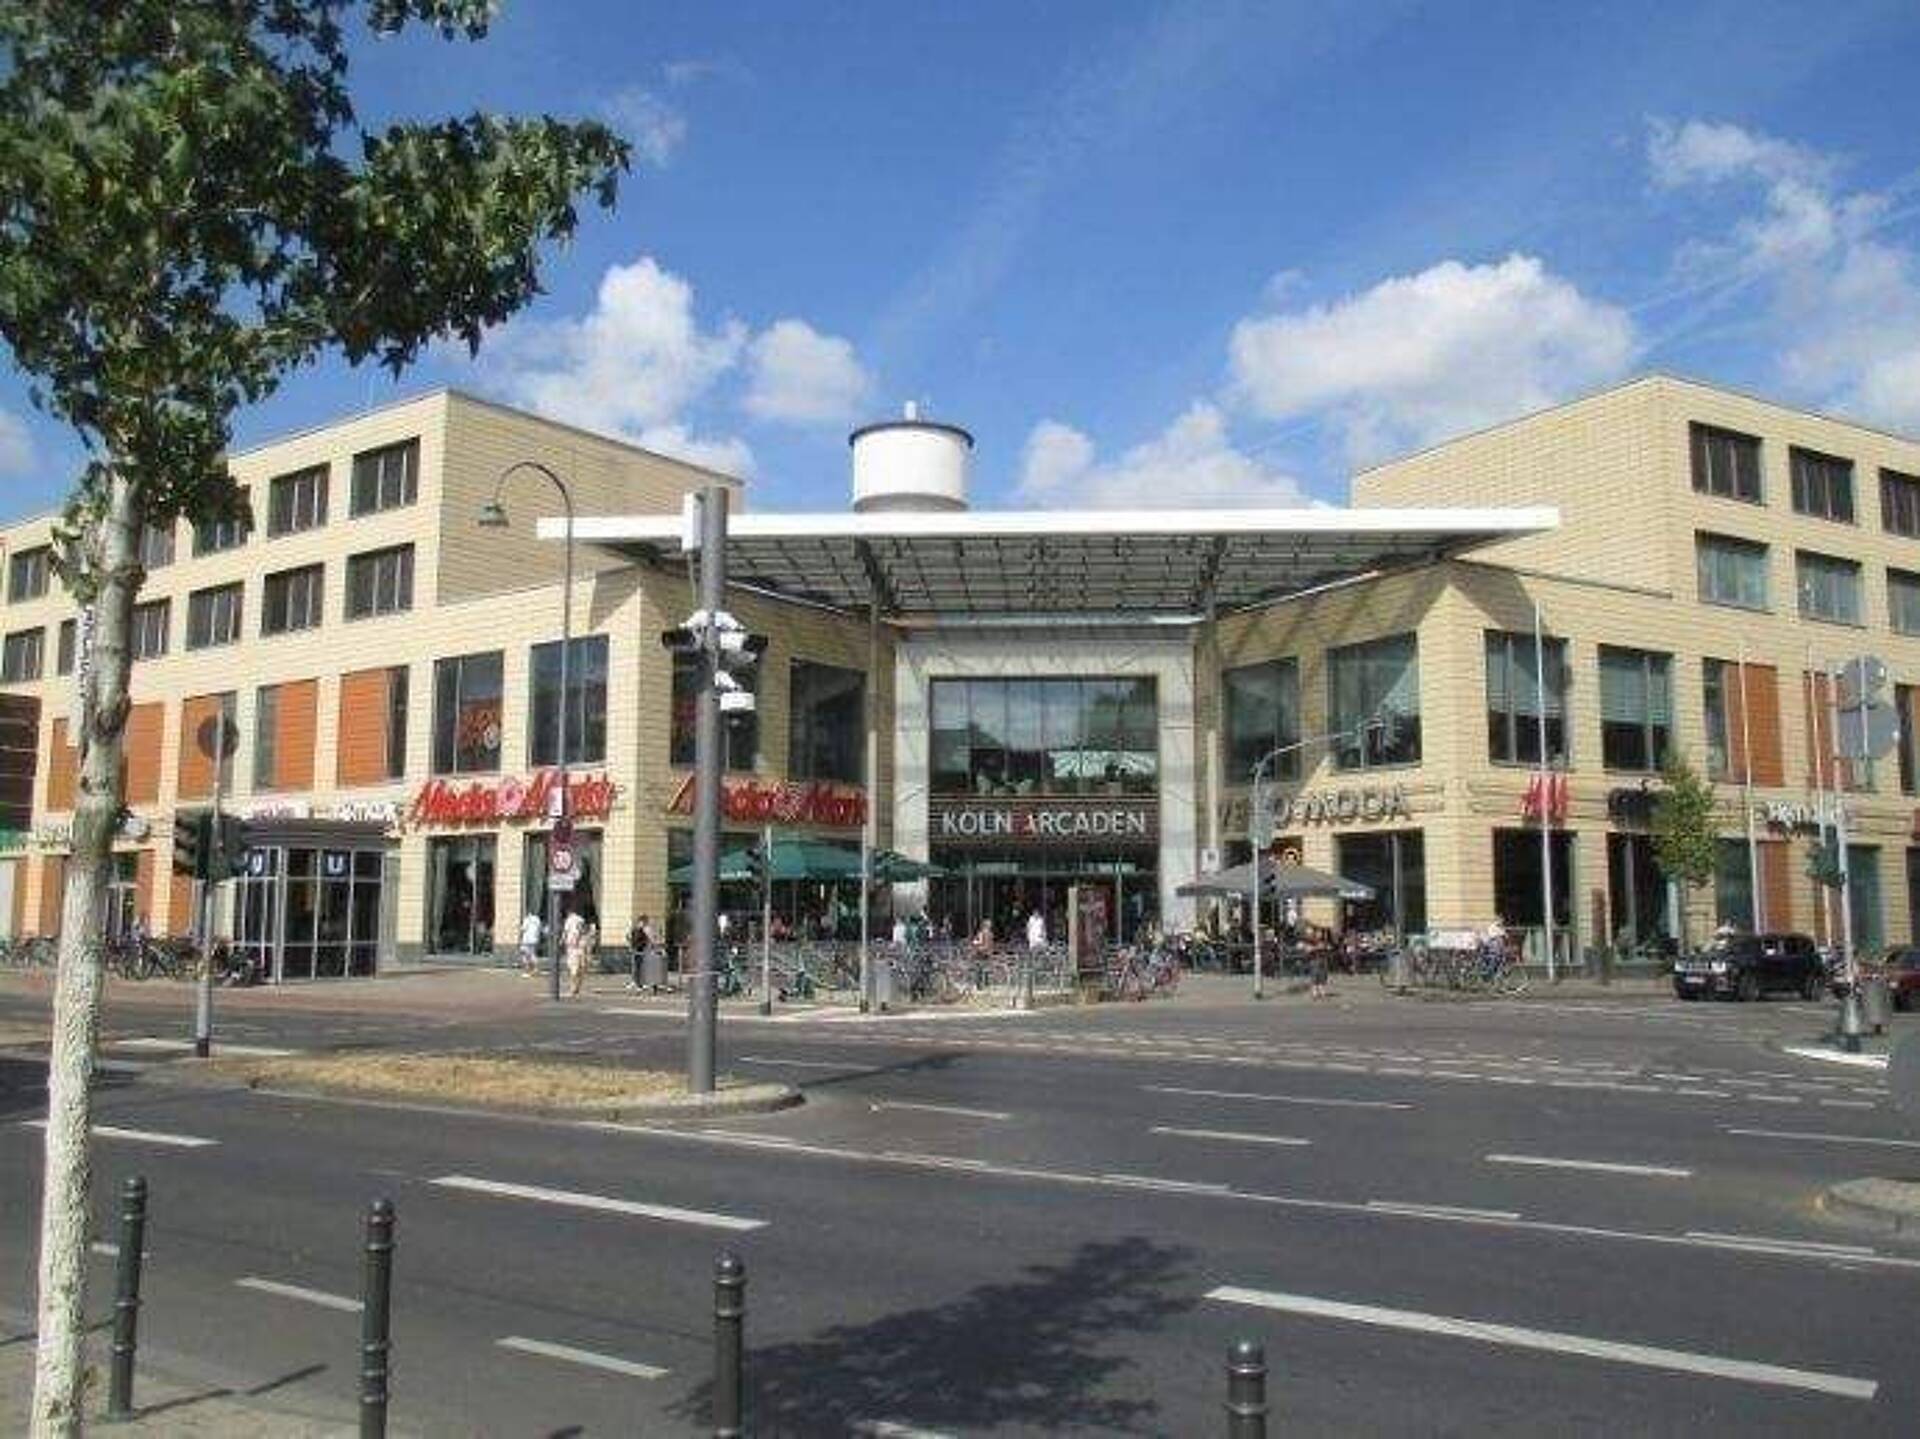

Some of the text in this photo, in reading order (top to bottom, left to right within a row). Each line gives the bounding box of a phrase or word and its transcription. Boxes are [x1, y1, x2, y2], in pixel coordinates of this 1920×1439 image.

[667, 772, 773, 822] Mdia
[941, 803, 1147, 834] KÖLN ARCADEN
[327, 855, 344, 875] U
